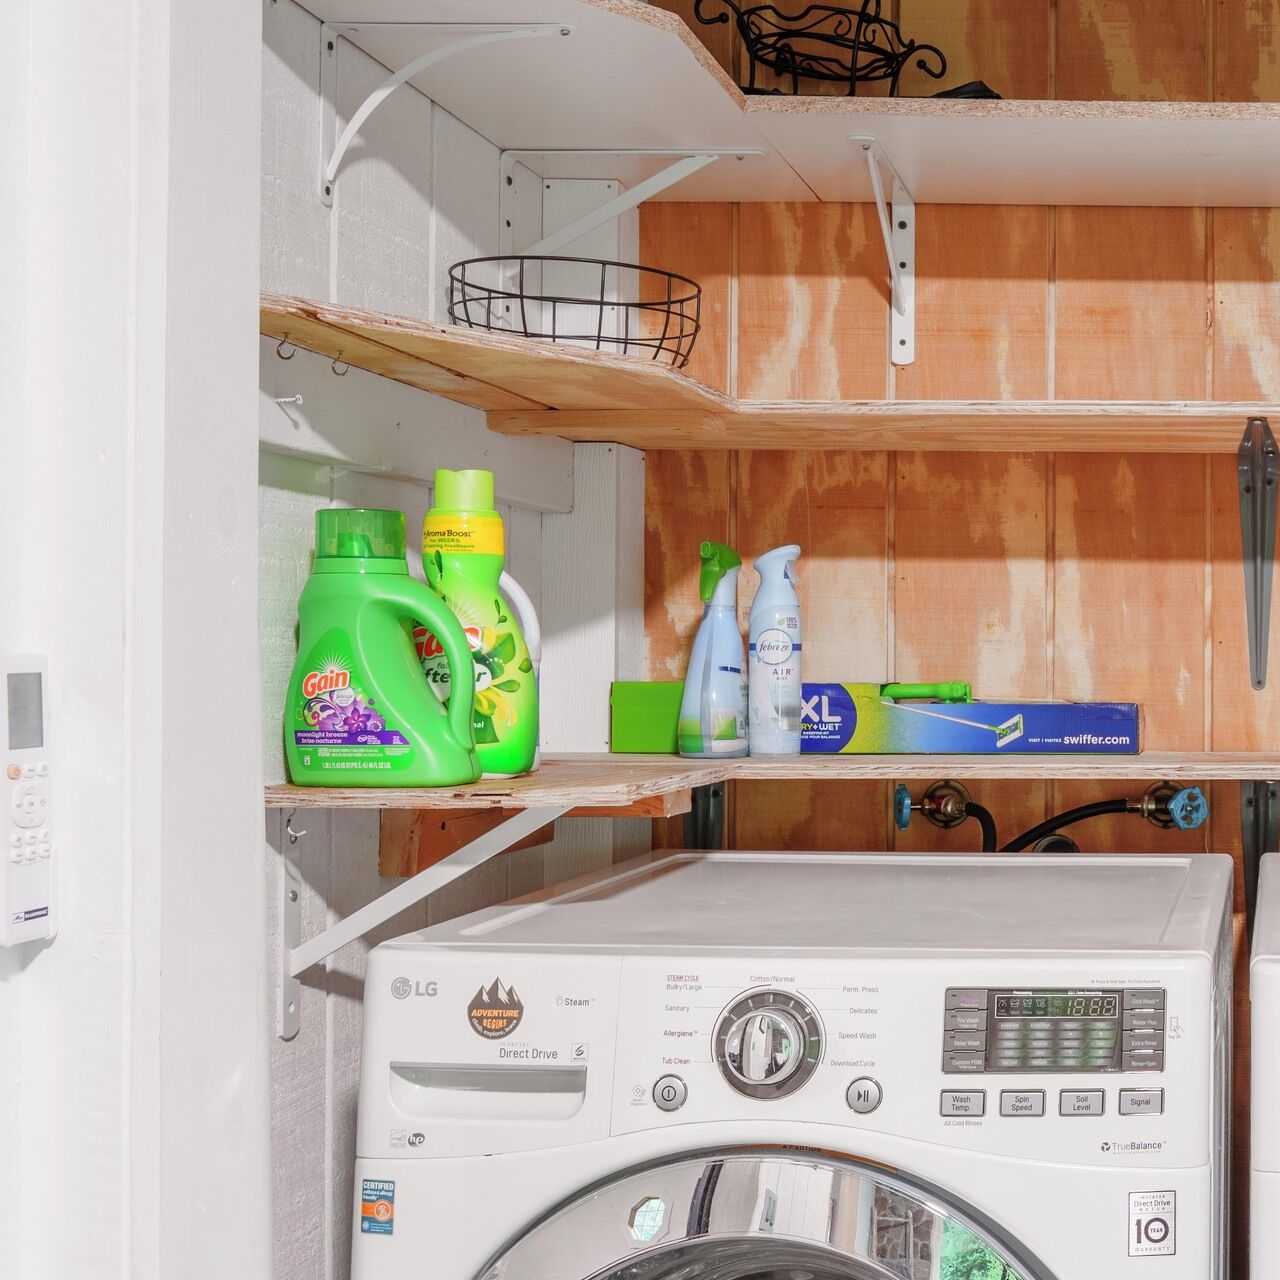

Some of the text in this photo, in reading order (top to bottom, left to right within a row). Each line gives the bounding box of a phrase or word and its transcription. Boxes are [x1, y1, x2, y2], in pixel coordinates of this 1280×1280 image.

[759, 640, 790, 652] febreze
[303, 669, 349, 698] Gain
[800, 695, 842, 723] XL
[801, 723, 840, 731] RY+WET
[1063, 734, 1130, 745] swiffer.com
[750, 975, 795, 983] Cotton/Normal
[414, 981, 438, 997] LG
[666, 983, 702, 992] Bulky/Large
[665, 1004, 690, 1012] Sanitary
[471, 1009, 520, 1017] ADVENTURE
[483, 1018, 507, 1029] BEGINS
[838, 1032, 858, 1040] Speed
[499, 1047, 558, 1059] Direct Drive
[662, 1057, 691, 1065] Tub Clean
[1014, 1096, 1030, 1104] Spin
[1076, 1095, 1088, 1103] Soil
[1130, 1098, 1151, 1107] Signal
[951, 1103, 970, 1112] Temp
[1011, 1103, 1033, 1112] Speed
[1073, 1103, 1091, 1111] Level
[1112, 1141, 1163, 1151] TrueBalance
[363, 1181, 394, 1190] CERTIFIED
[1135, 1217, 1169, 1243] 10
